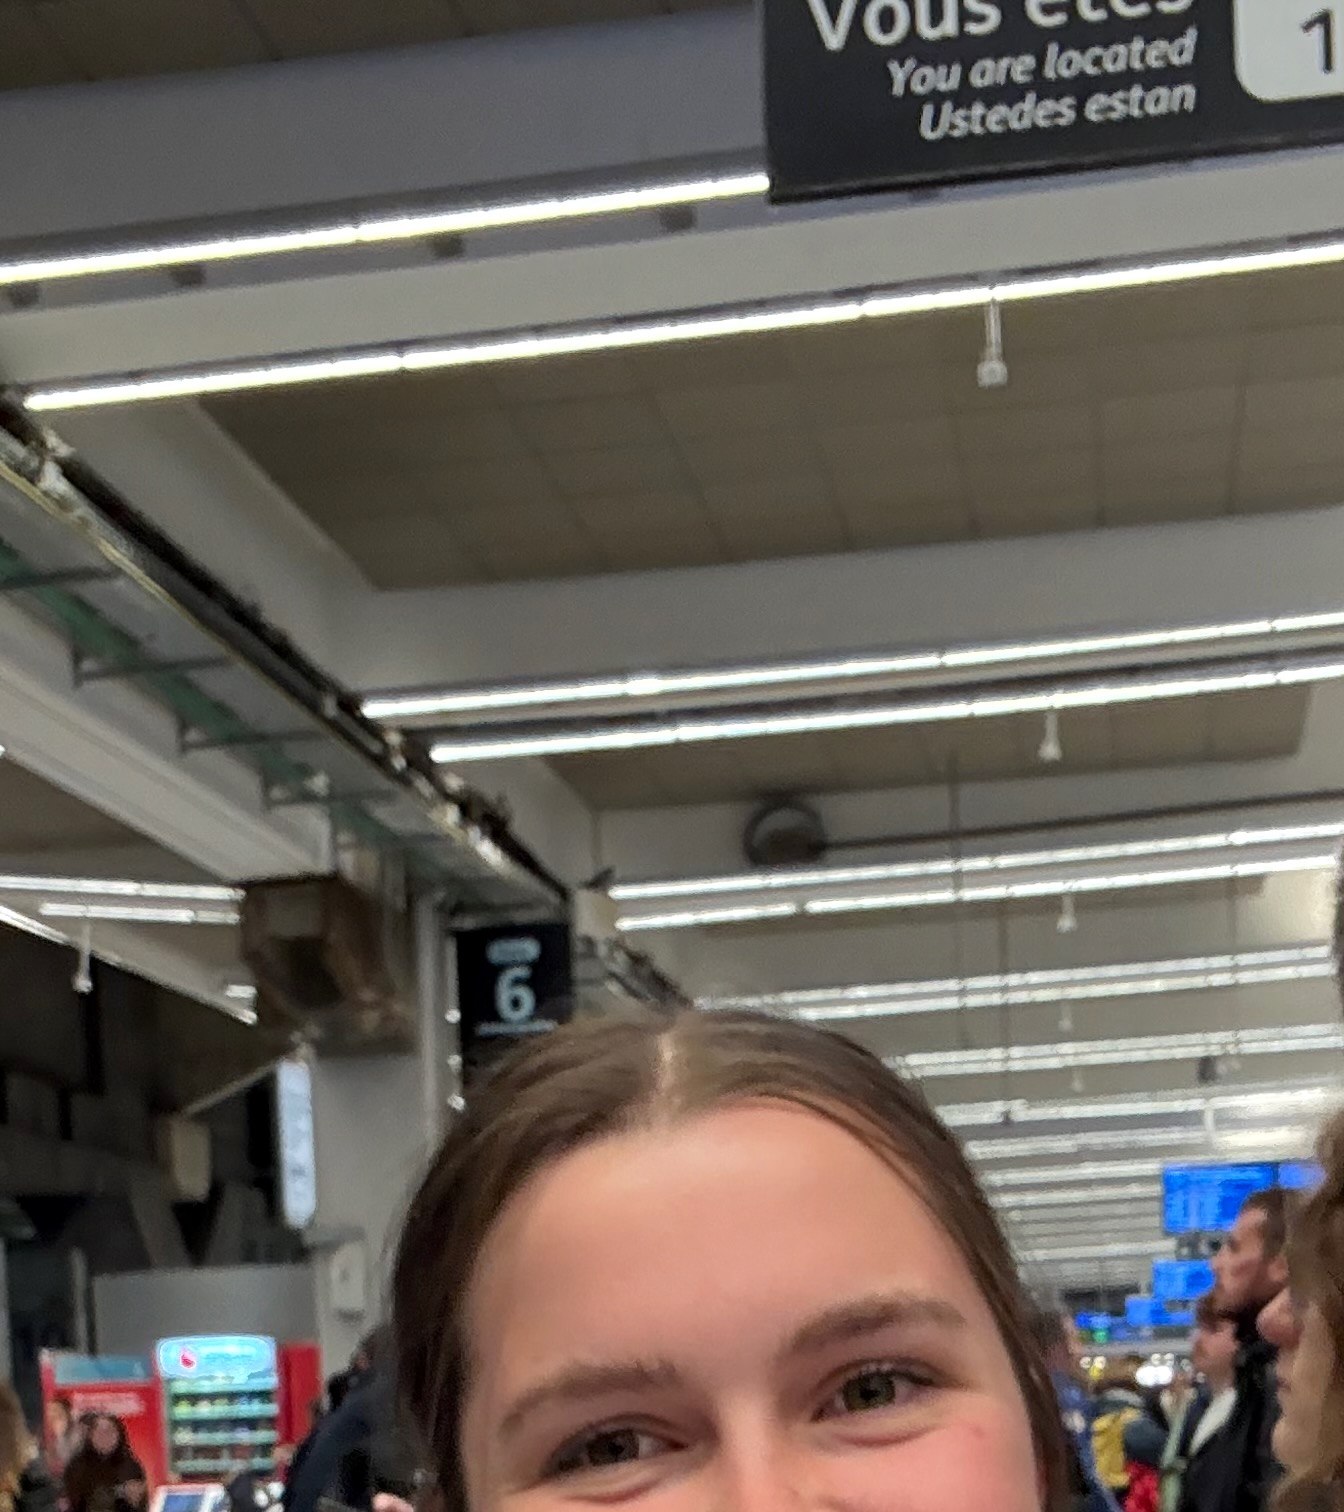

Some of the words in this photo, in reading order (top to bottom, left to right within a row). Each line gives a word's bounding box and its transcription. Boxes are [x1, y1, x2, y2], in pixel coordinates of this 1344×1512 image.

[809, 0, 1002, 51] Vous
[1301, 8, 1334, 74] 1
[886, 56, 962, 97] You
[968, 53, 1036, 86] are
[1043, 25, 1198, 81] located
[918, 92, 1077, 140] Ustedes
[1083, 83, 1197, 122] estan
[495, 965, 536, 1022] 6
